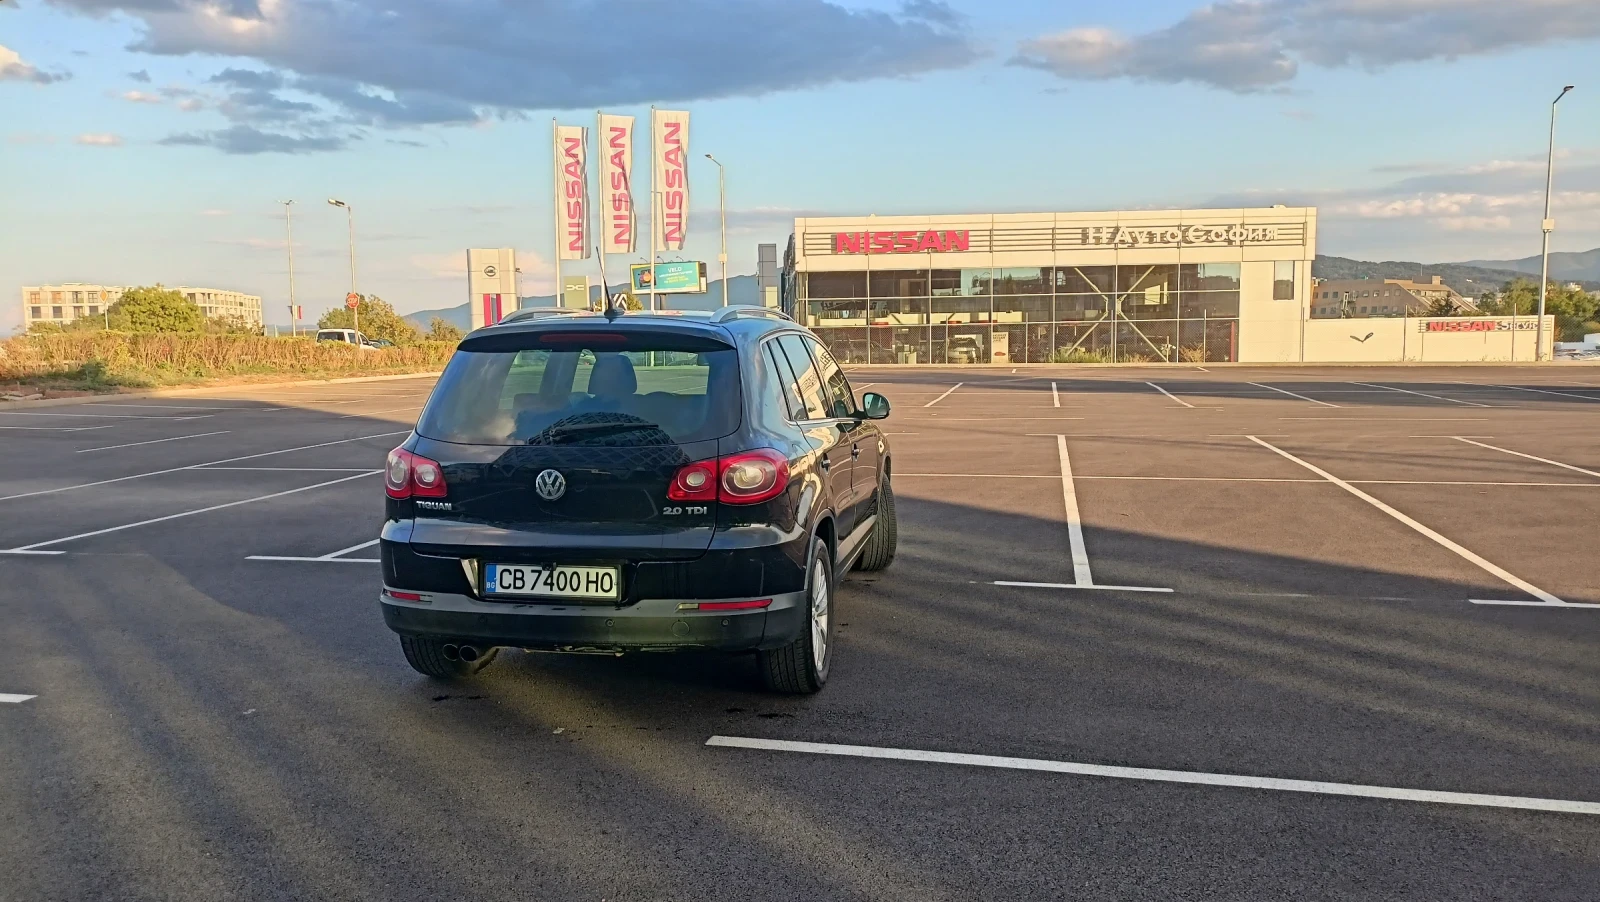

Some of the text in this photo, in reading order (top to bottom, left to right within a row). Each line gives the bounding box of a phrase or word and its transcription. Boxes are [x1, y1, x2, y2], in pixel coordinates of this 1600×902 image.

[564, 137, 584, 252] NISSAN
[609, 126, 631, 245] NISSAN
[664, 122, 683, 242] NISSAN
[836, 229, 970, 254] NISSAN
[1187, 223, 1279, 247] София
[1429, 320, 1541, 332] NISSAN Servic
[416, 500, 452, 511] TIGUAN
[685, 506, 708, 515] TDI
[486, 568, 614, 593] BG CB 7400 HO
